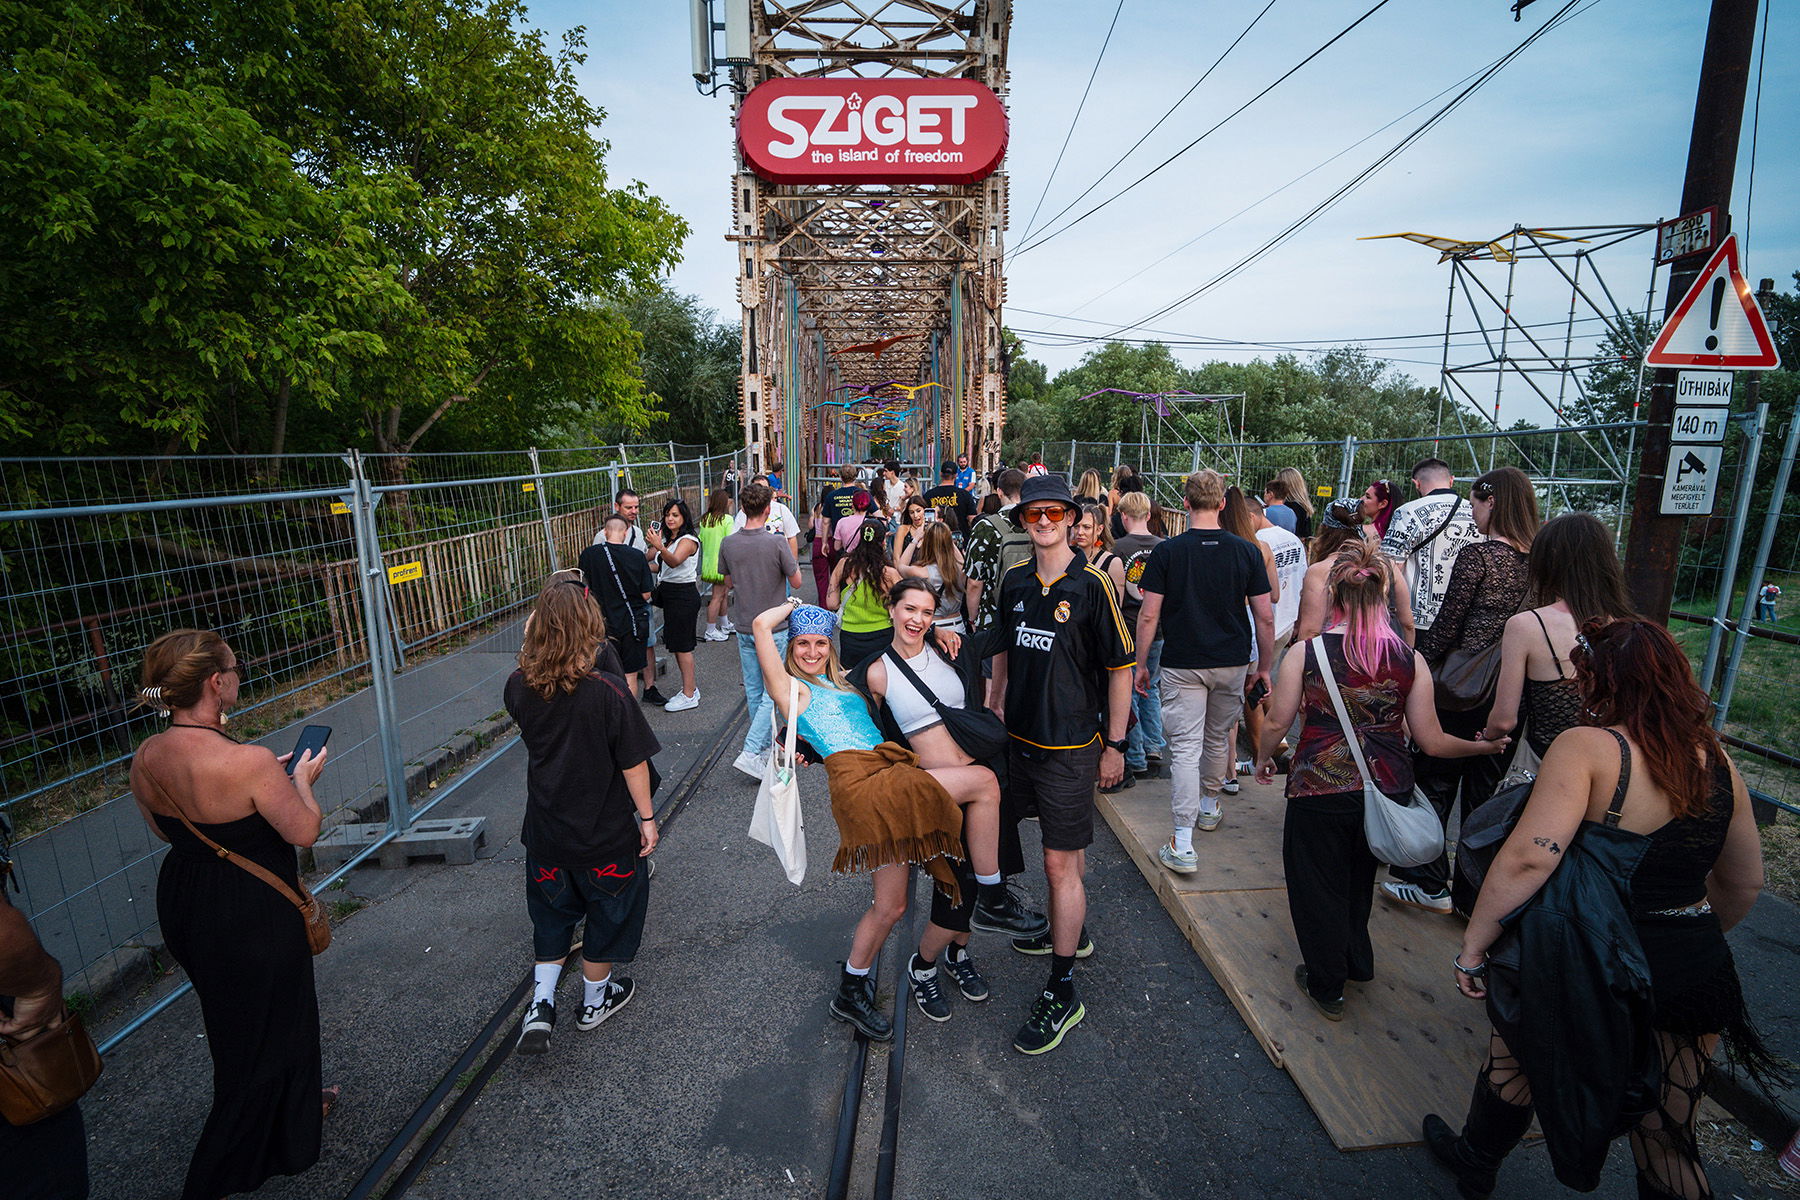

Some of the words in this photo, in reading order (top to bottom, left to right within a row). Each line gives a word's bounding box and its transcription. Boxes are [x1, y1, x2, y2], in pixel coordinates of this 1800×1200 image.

[811, 150, 833, 164] the
[838, 148, 878, 163] island
[885, 149, 899, 163] of
[904, 150, 963, 163] freedom
[1679, 377, 1730, 396] ÚTHIBÁK
[1676, 415, 1700, 434] 140
[1702, 420, 1718, 434] m
[1671, 483, 1707, 492] KAMERÁVAL
[1671, 493, 1706, 501] MEGFIGYELT
[1674, 501, 1700, 510] TERÜLET
[392, 566, 418, 580] profirent
